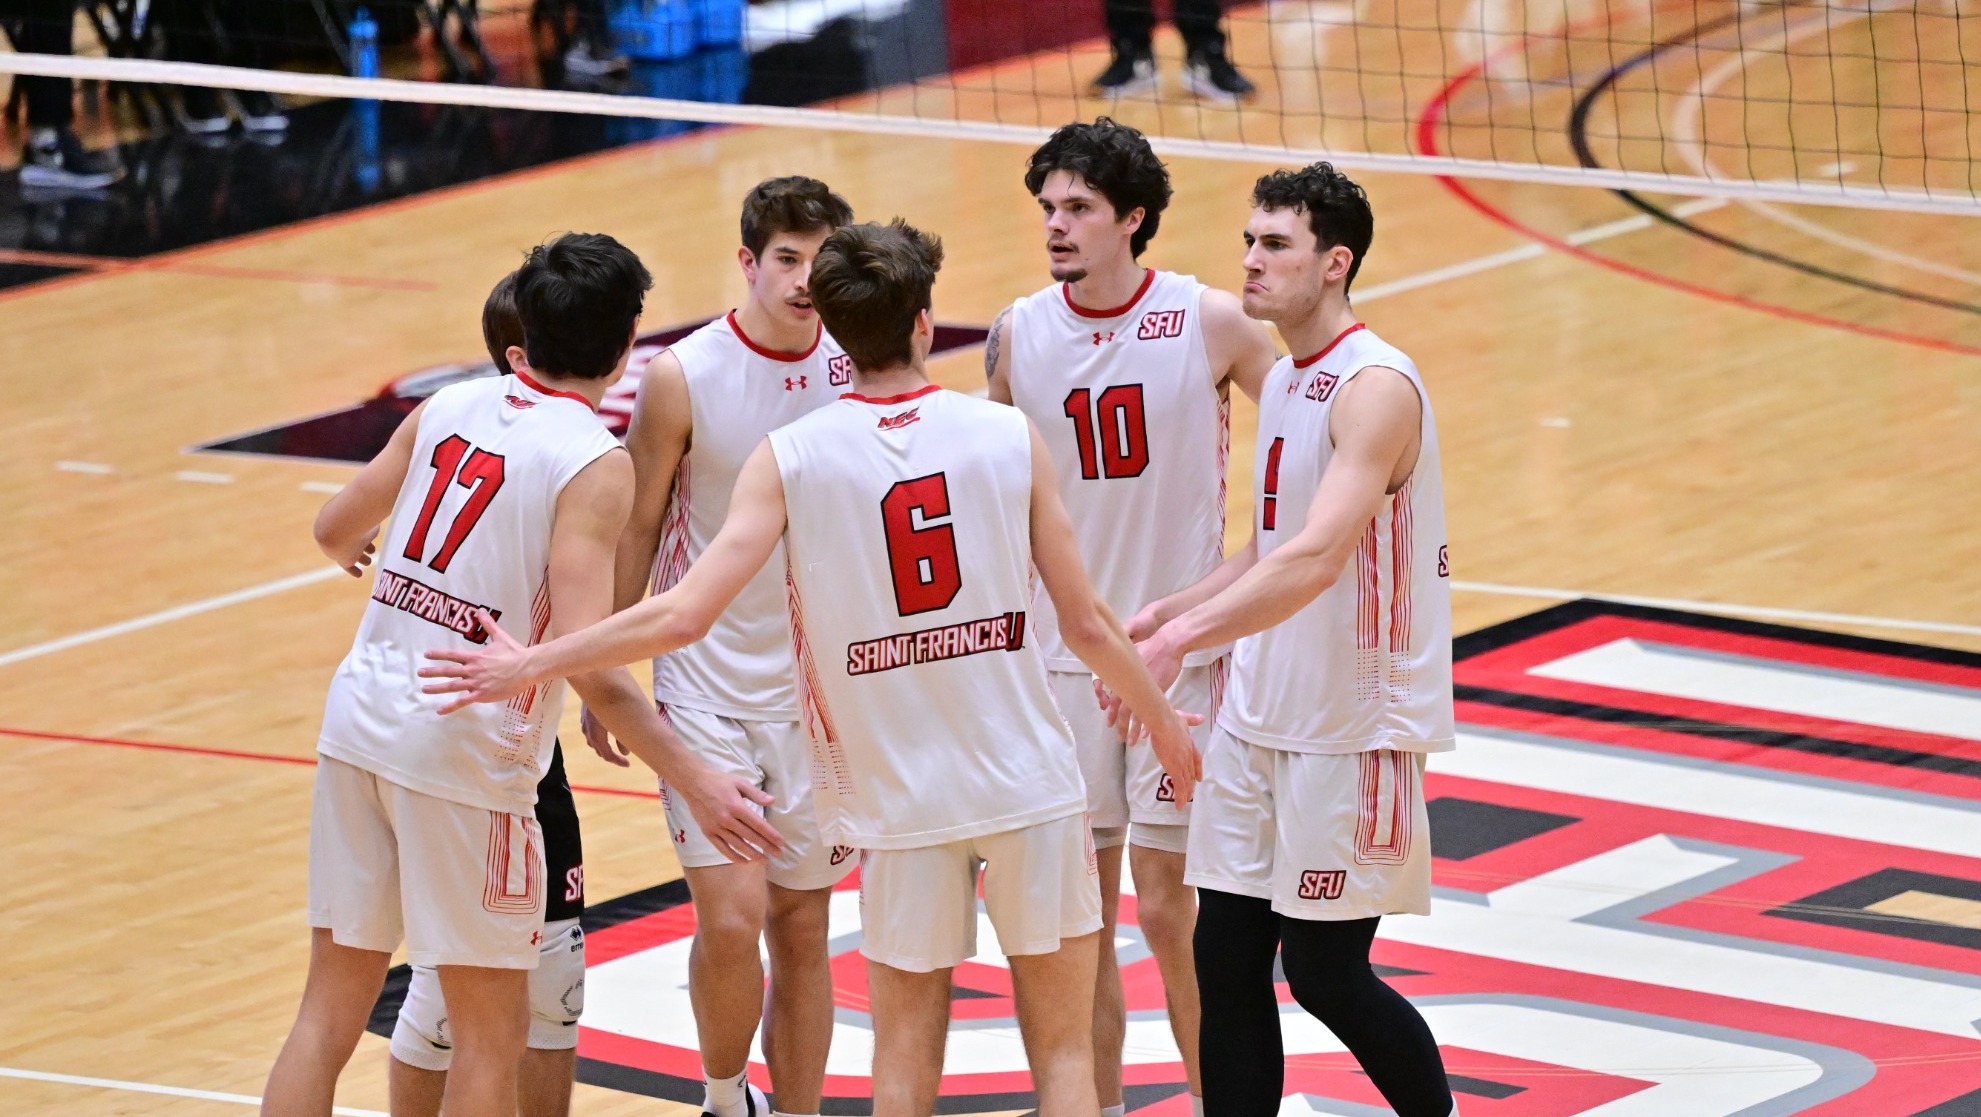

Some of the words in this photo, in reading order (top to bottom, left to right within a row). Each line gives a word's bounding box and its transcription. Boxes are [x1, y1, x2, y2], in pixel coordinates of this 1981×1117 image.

[1137, 309, 1185, 340] SFU
[828, 354, 852, 386] SF
[1305, 371, 1339, 402] SFU
[1063, 383, 1149, 480] 10
[403, 433, 505, 574] 17
[880, 471, 962, 617] 6
[847, 632, 914, 676] SAINT
[1298, 870, 1346, 900] SFU
